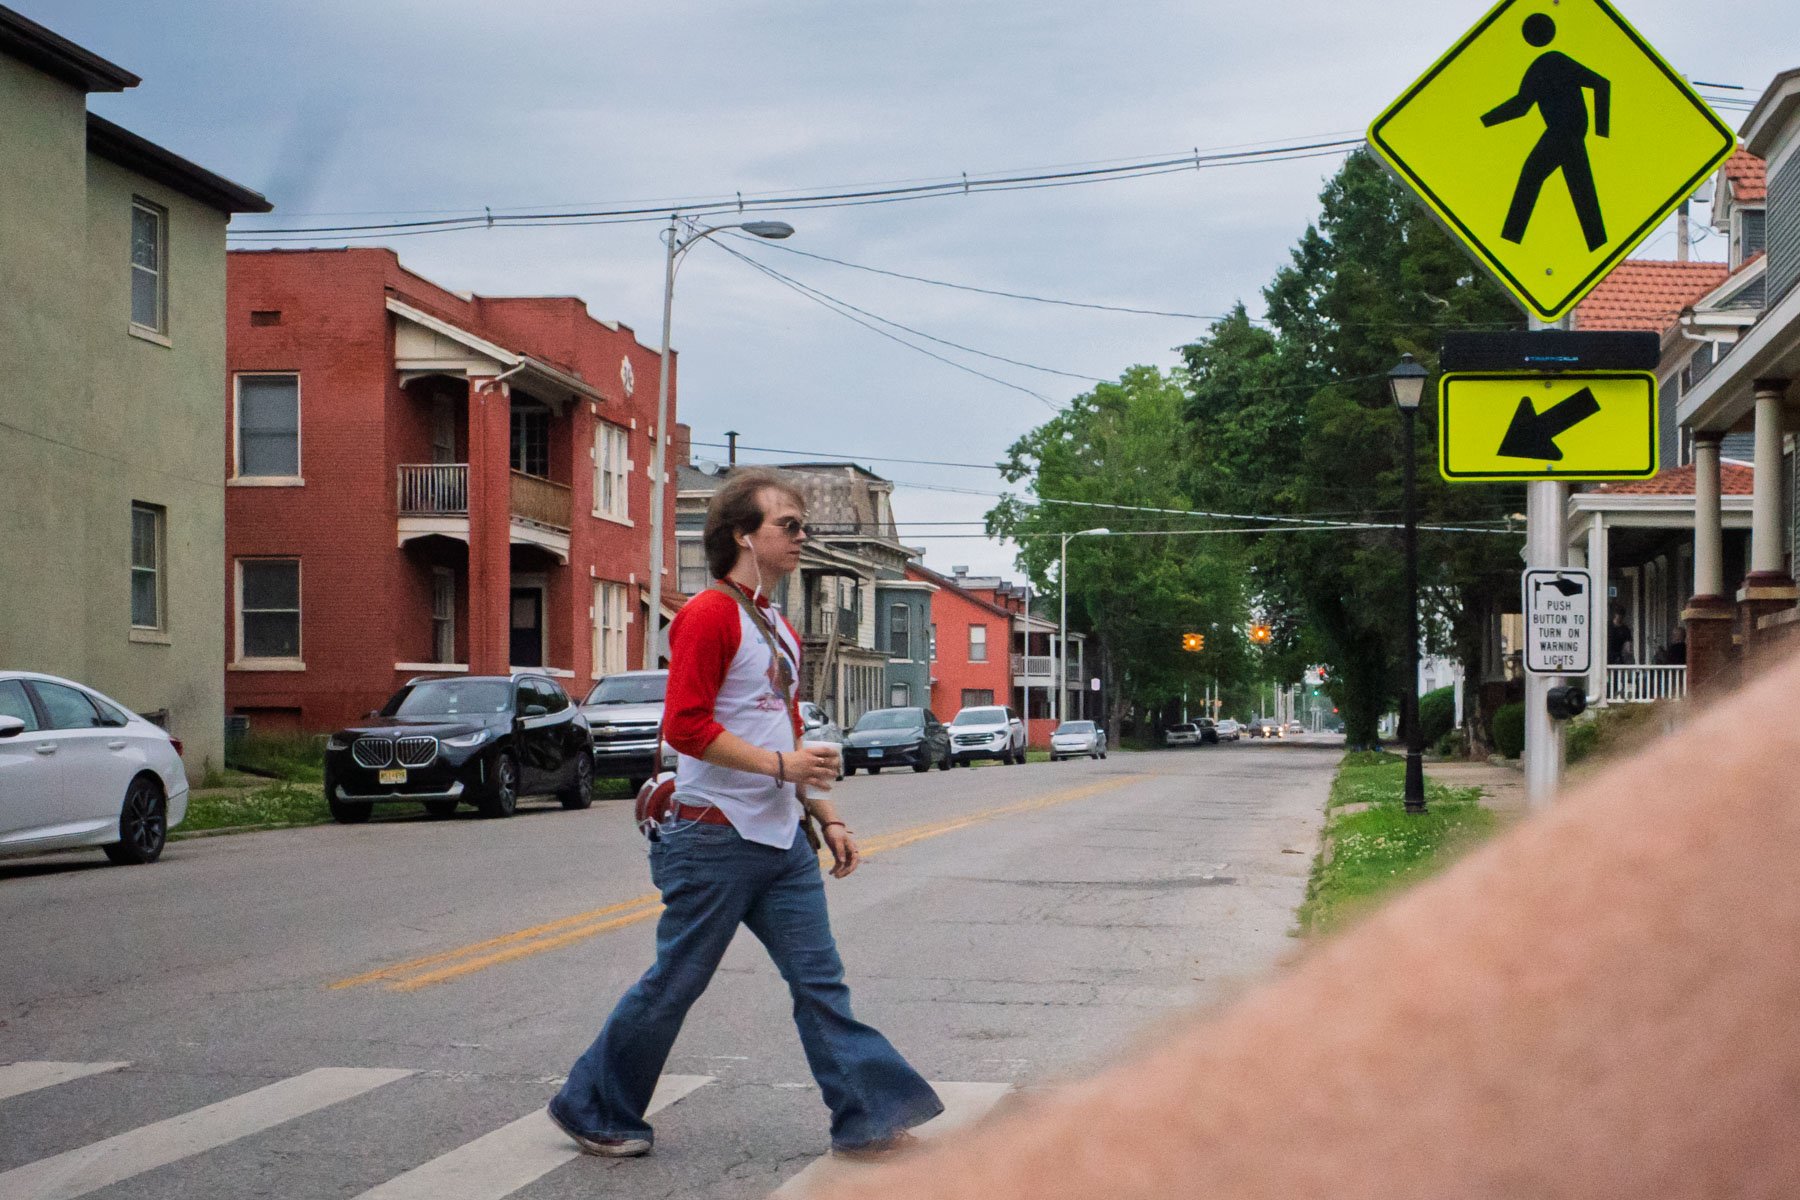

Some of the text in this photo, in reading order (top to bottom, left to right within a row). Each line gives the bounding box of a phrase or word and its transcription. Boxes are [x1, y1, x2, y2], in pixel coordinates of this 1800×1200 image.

[1547, 600, 1571, 610] PUSH
[1533, 614, 1584, 624] BUTTON TO
[1539, 627, 1580, 638] TURN ON
[1540, 641, 1578, 652] WARNING
[1543, 655, 1574, 665] LIGHTS
